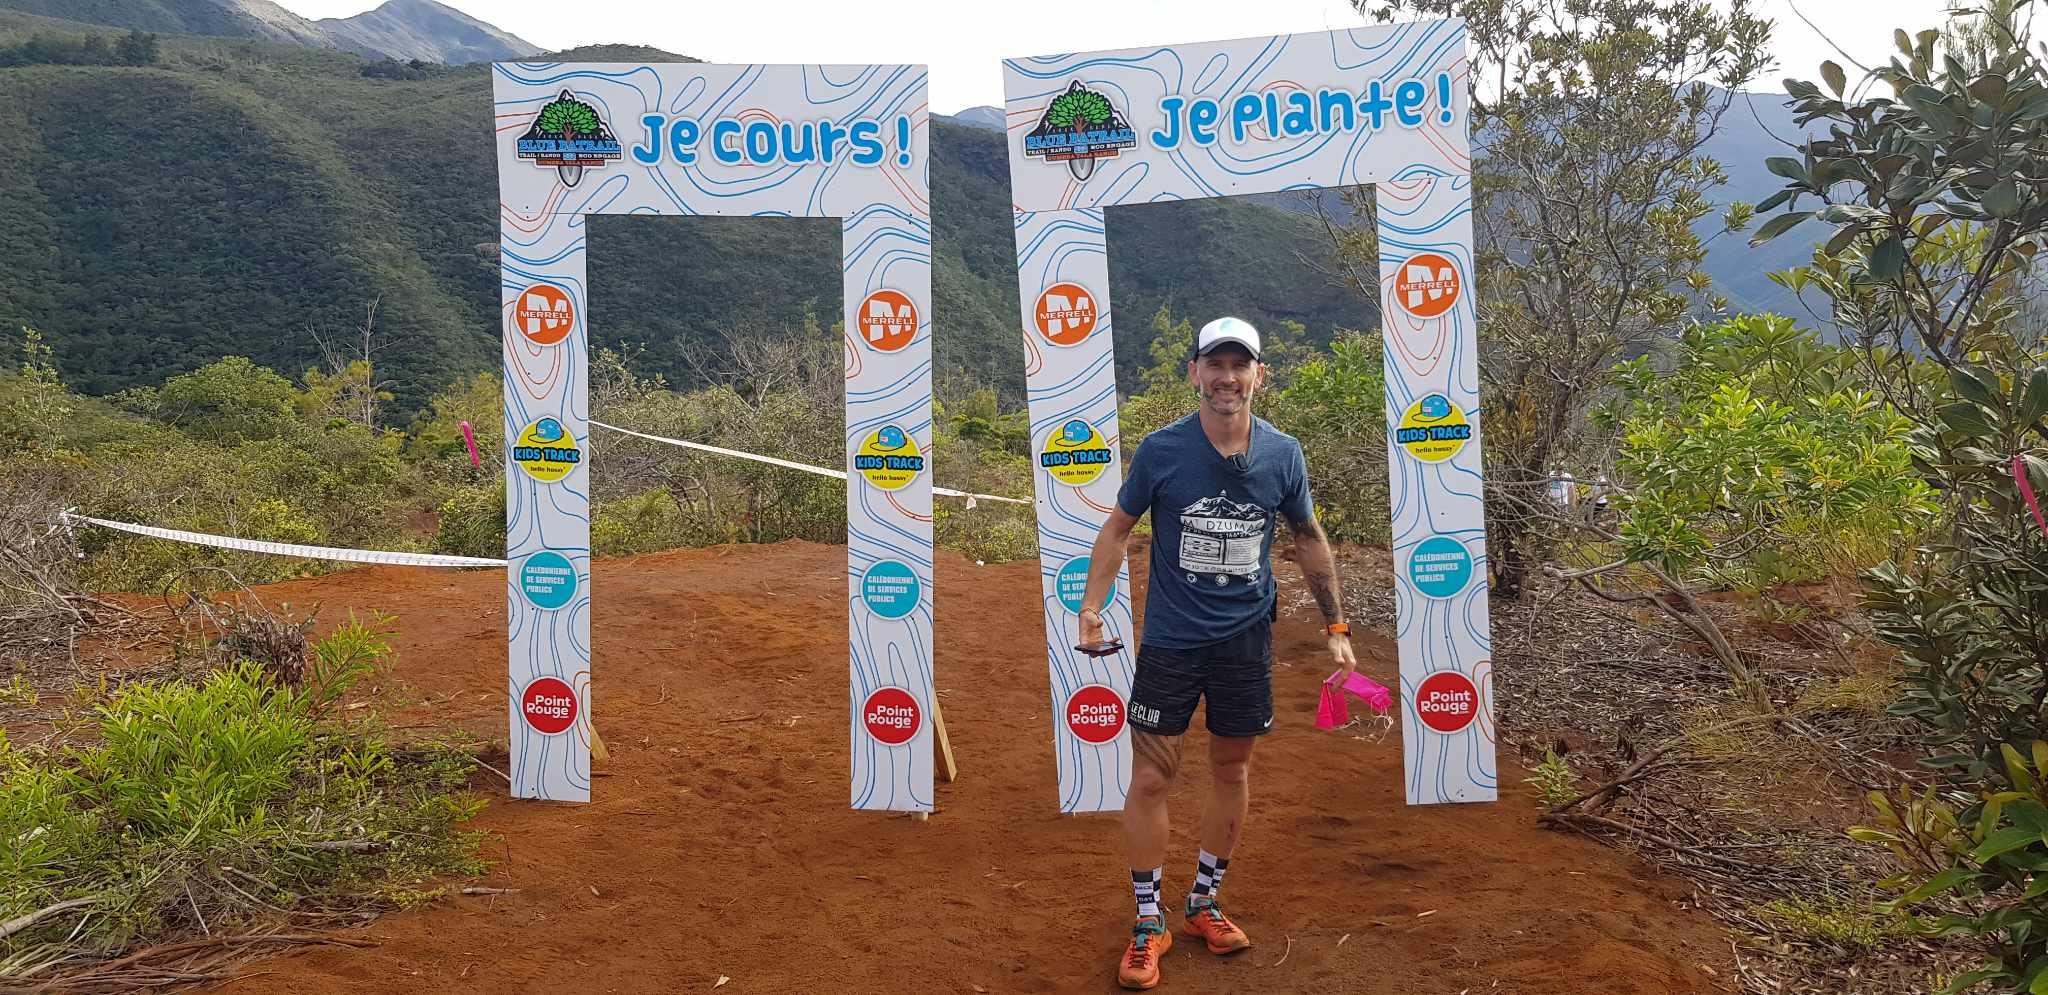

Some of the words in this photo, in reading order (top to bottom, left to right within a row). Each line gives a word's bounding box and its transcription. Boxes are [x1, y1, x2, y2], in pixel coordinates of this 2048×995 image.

[1151, 98, 1218, 149] Je
[519, 140, 557, 151] BLUE
[632, 115, 699, 164] Je
[713, 119, 885, 165] cours
[1026, 134, 1066, 147] BLUE
[1400, 280, 1457, 291] MERRELL
[520, 310, 572, 319] MERRELL
[862, 317, 916, 325] MERRELL
[1040, 310, 1094, 320] MERRELL
[1398, 428, 1427, 442] KIDS
[1429, 425, 1470, 440] TRACK
[515, 448, 541, 460] KIDS
[543, 448, 580, 462] TRACK
[1042, 452, 1069, 466] KIDS
[1072, 450, 1110, 463] TRACK
[856, 456, 883, 469] KIDS
[886, 456, 923, 470] TRACK
[535, 695, 572, 707] Point
[1430, 690, 1471, 703] Point
[526, 702, 569, 719] Rouge
[876, 705, 914, 717] Point
[1079, 702, 1119, 715] Point
[1131, 704, 1138, 714] LE
[1137, 704, 1160, 723] CLUB
[1420, 700, 1469, 715] Rouge
[867, 712, 912, 729] Rouge
[1071, 713, 1117, 727] Rouge
